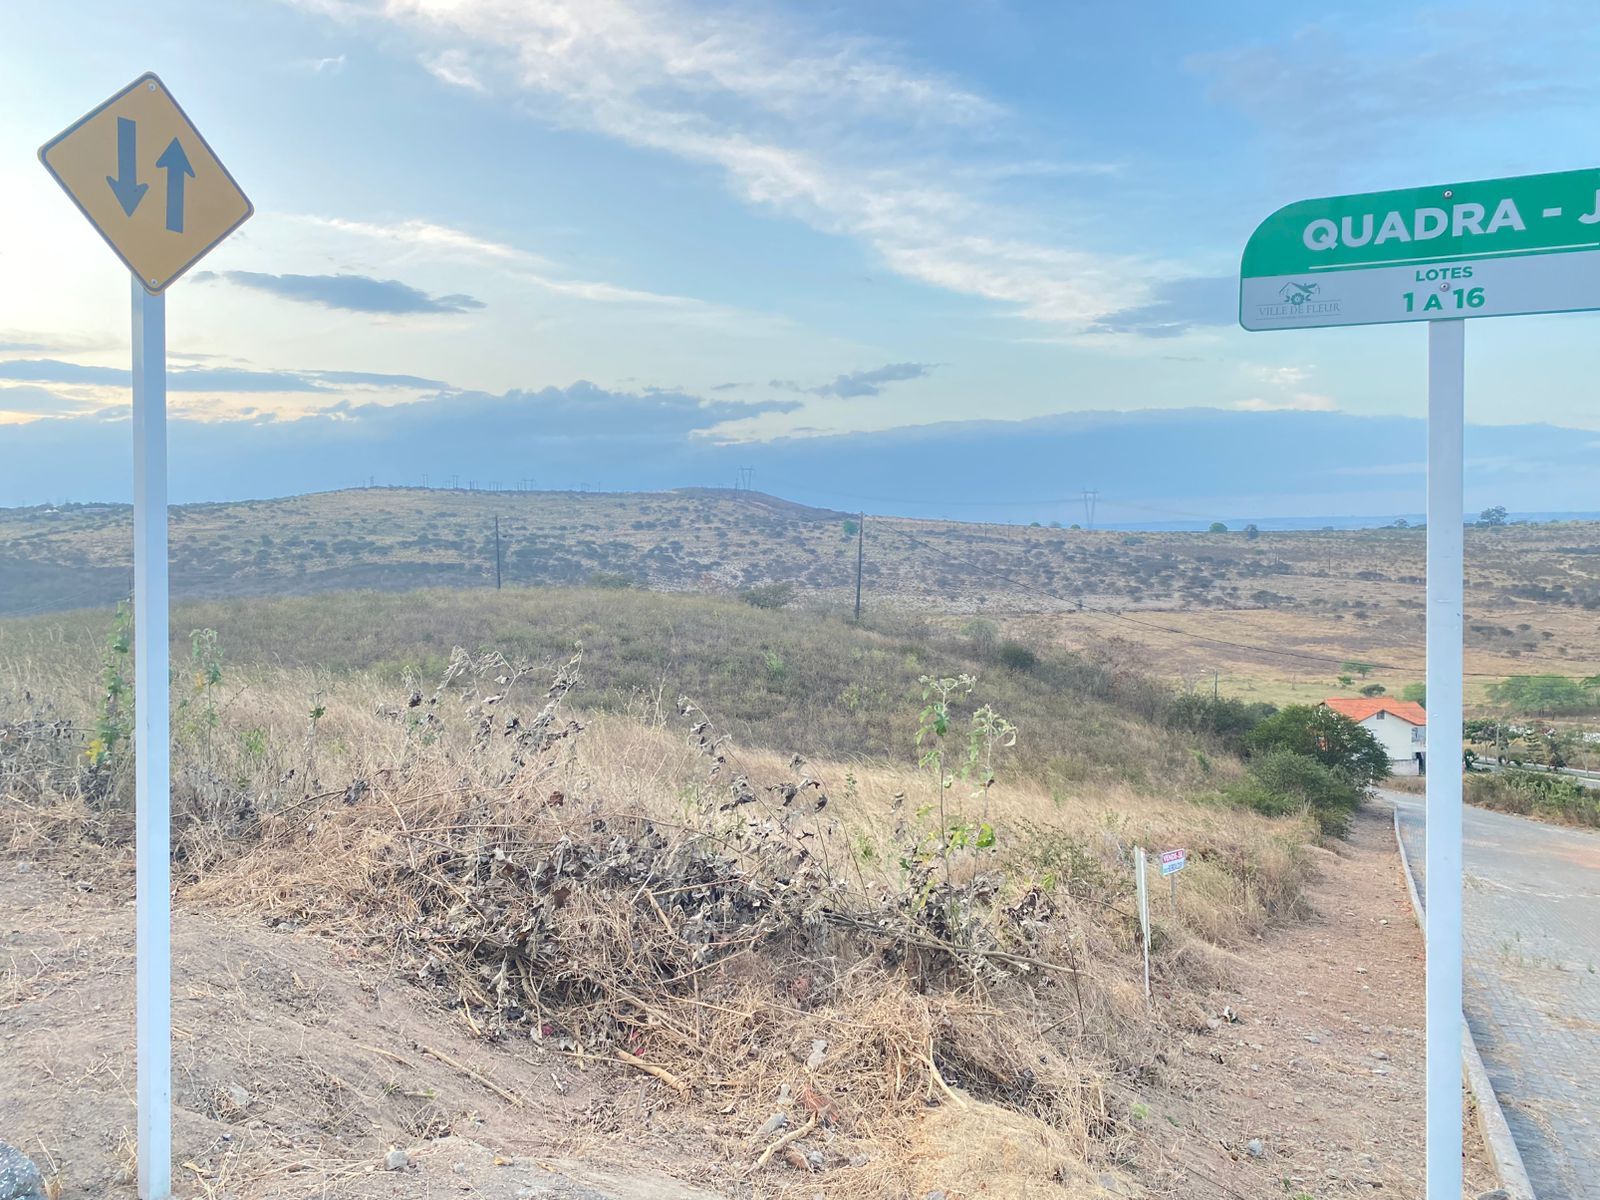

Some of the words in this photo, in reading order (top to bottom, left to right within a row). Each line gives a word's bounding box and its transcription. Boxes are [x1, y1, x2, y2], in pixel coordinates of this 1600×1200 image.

[1303, 198, 1526, 251] QUADRA
[1543, 207, 1562, 217] -
[1415, 266, 1473, 282] LOTES
[1259, 306, 1287, 316] VILLE
[1290, 305, 1304, 315] DE
[1306, 303, 1340, 313] FLEUR
[1402, 292, 1413, 312] 1
[1423, 293, 1443, 311] A
[1453, 287, 1485, 309] 16
